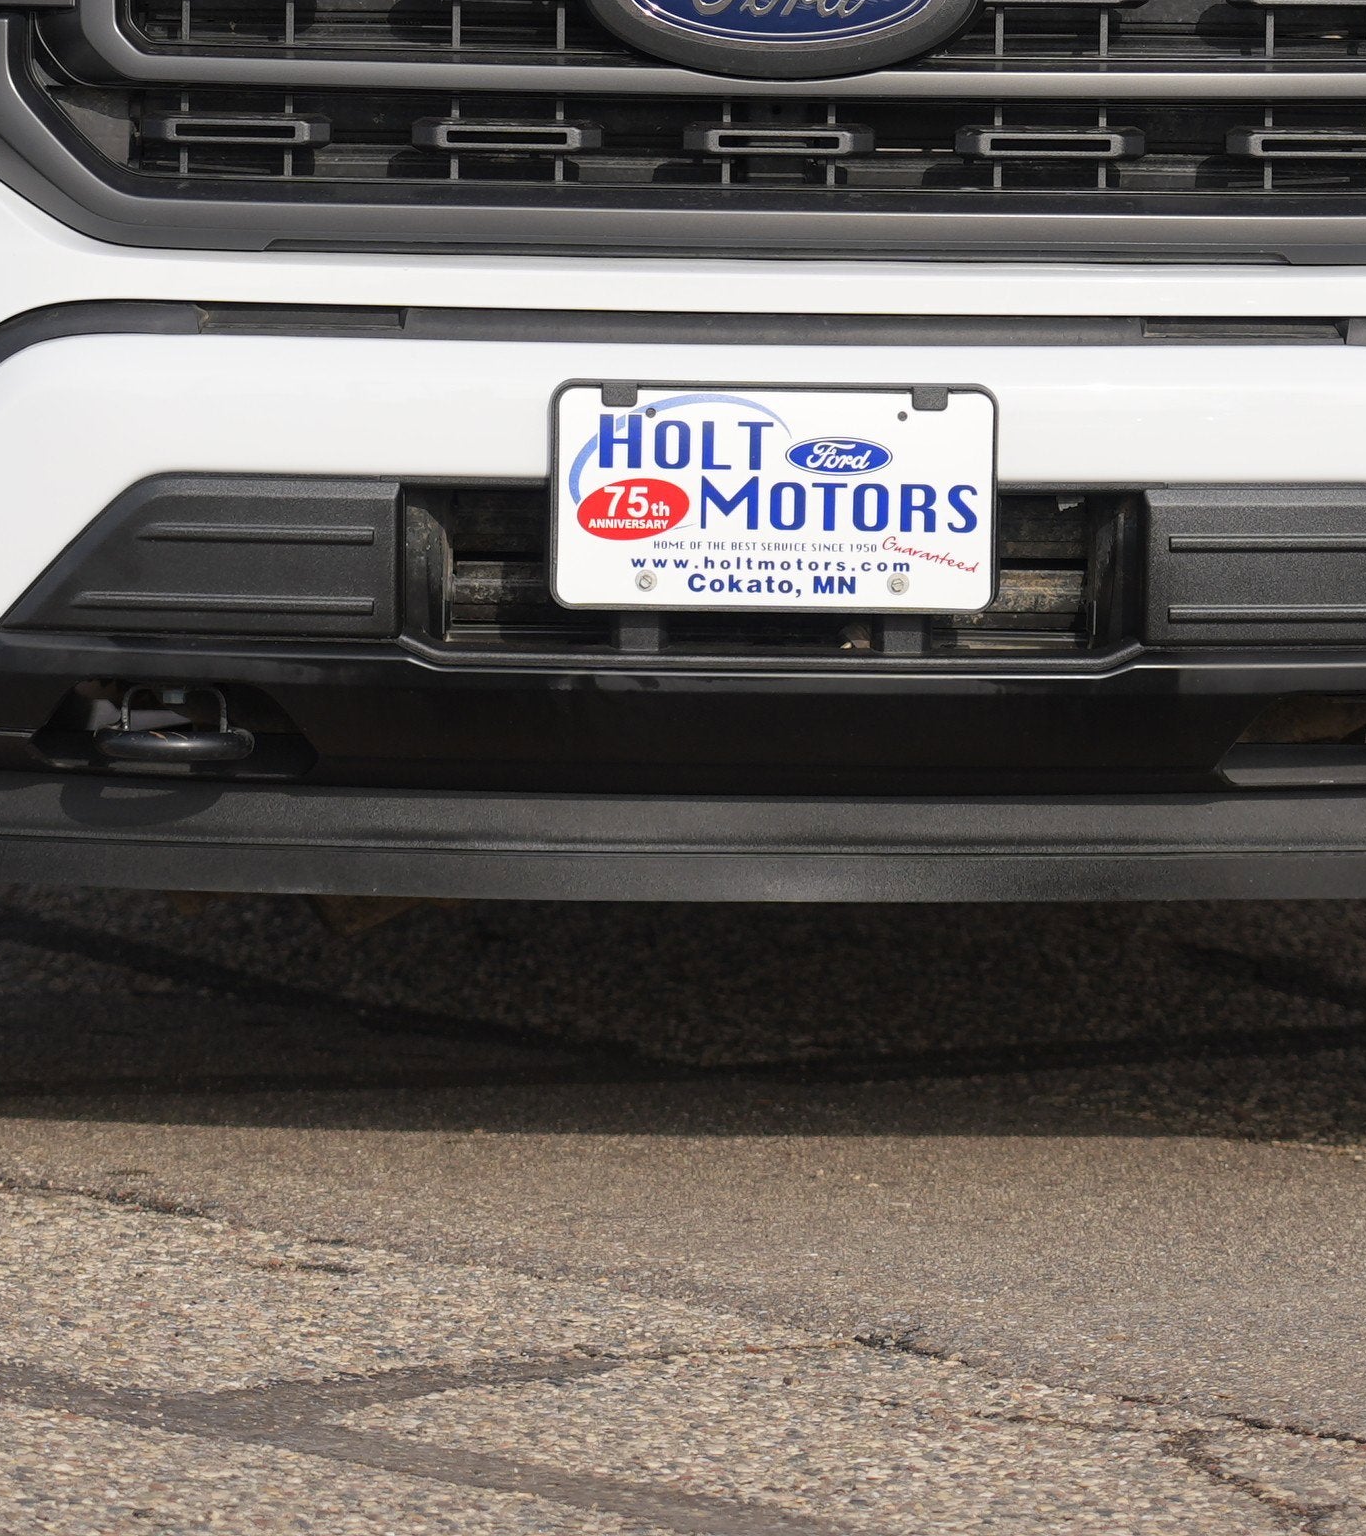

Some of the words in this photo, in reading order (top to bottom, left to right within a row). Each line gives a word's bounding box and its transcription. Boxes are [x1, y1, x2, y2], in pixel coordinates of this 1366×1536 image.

[599, 413, 774, 471] HOLT
[806, 443, 871, 471] Ford
[603, 485, 671, 518] 75th
[700, 475, 978, 534] MOTORS
[588, 517, 669, 531] ANNIVERSARY
[653, 540, 685, 550] HOME
[689, 541, 702, 550] OF
[707, 541, 726, 551] THE
[731, 541, 757, 551] BEST
[761, 542, 807, 552] SERVICE
[811, 542, 844, 553] SINCE
[849, 543, 878, 553] 1950
[882, 536, 980, 573] Guaranteed
[631, 556, 910, 572] www.holtmotors.com
[687, 573, 802, 597] Cokato,
[813, 575, 856, 595] MN
